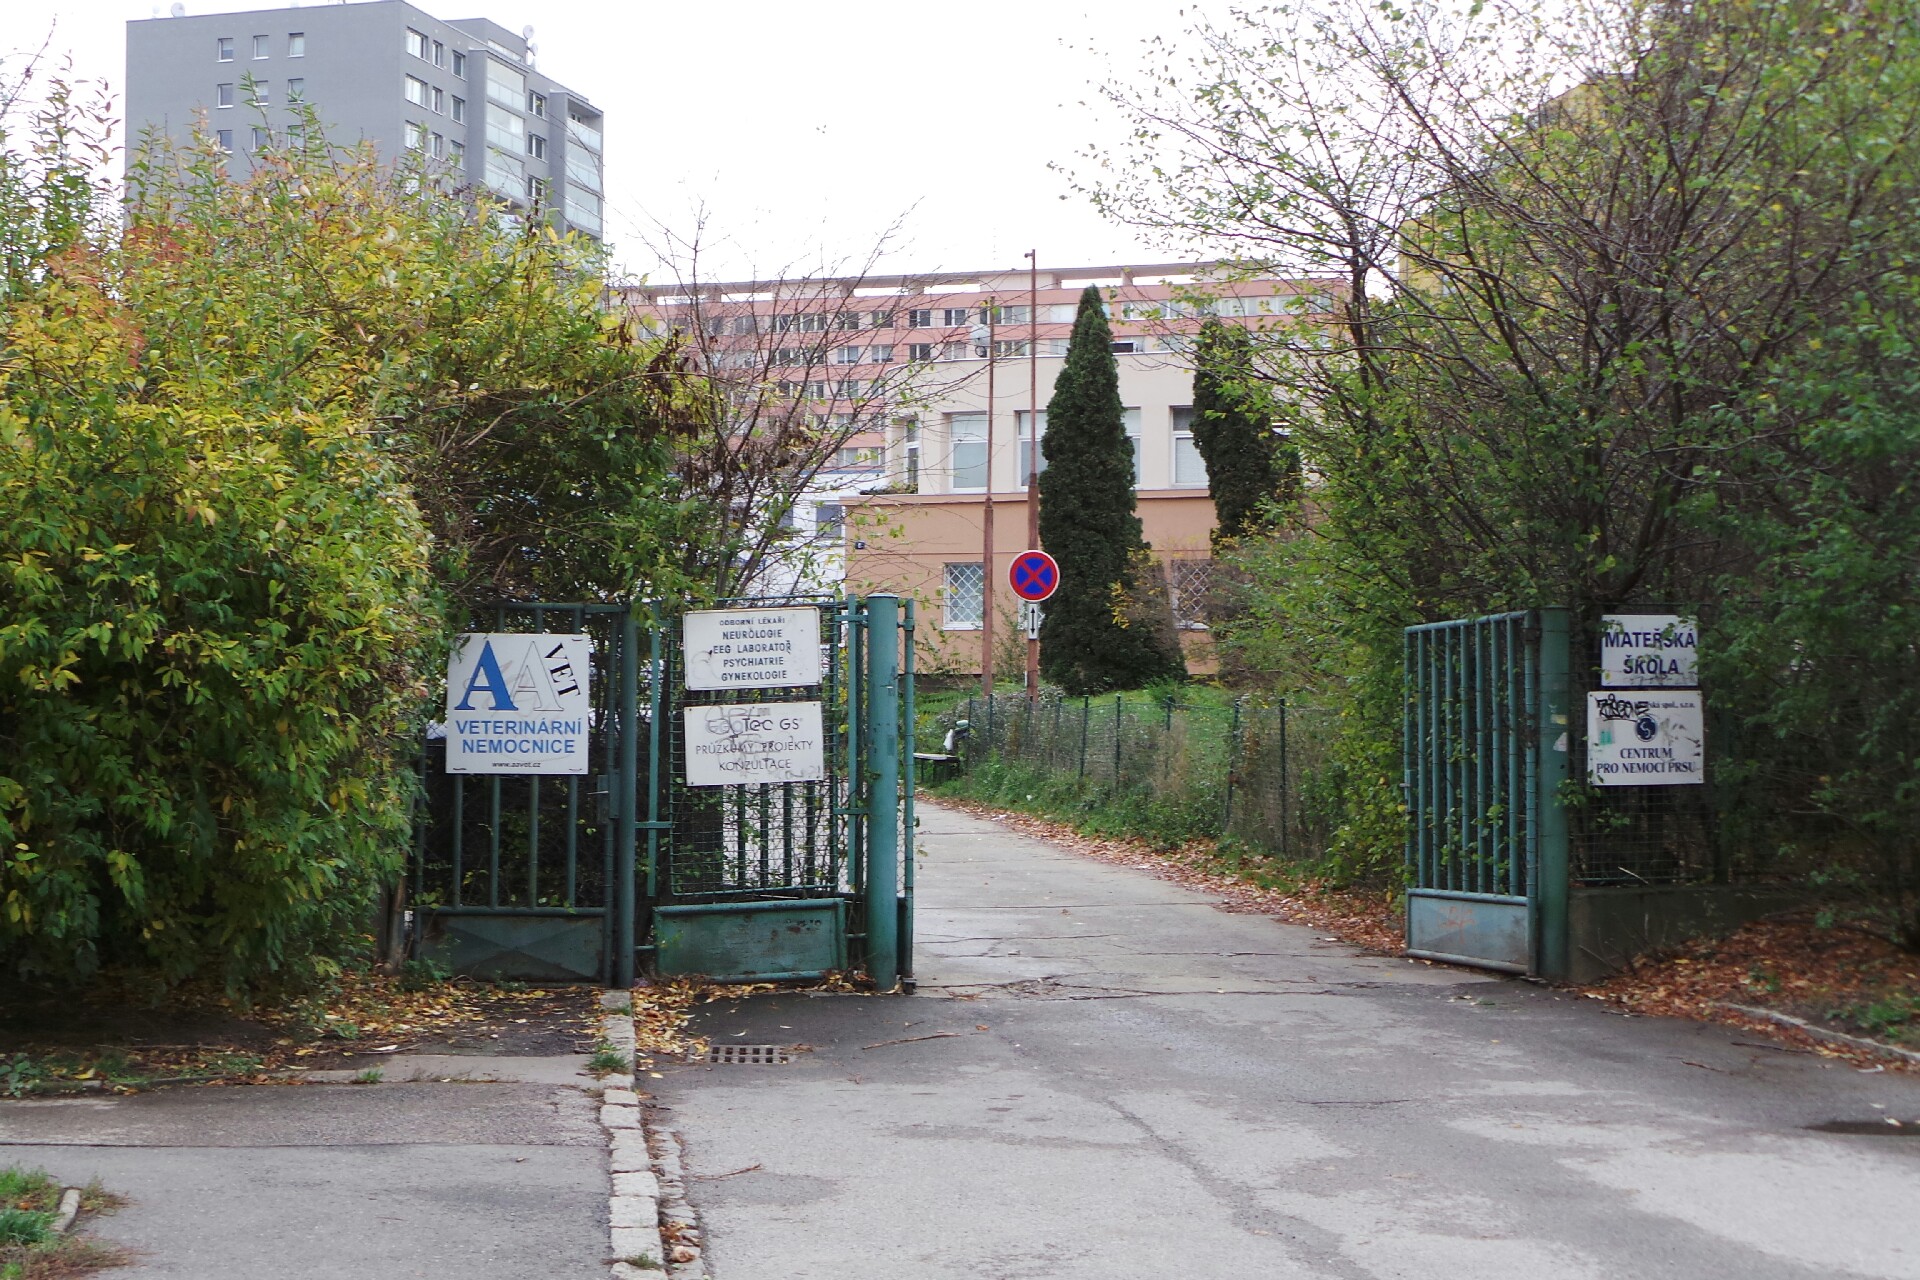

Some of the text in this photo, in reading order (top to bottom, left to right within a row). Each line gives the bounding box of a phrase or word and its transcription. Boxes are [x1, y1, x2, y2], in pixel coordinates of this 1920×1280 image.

[719, 616, 785, 626] ODBORNÍ LÉKAŘI
[722, 629, 783, 640] NEUROLOGIE
[1605, 628, 1696, 648] MATEŘSKÁ
[713, 640, 792, 654] EEG LABORATOŘ
[723, 656, 784, 668] PSYCHIATRIE
[1623, 654, 1680, 674] ŠKOLA
[544, 642, 581, 698] VET
[721, 670, 788, 682] GYNEKOLOGIE
[455, 717, 582, 735] VETERINÁRNÍ
[779, 718, 800, 731] GS
[462, 739, 575, 754] NEMOCNICE
[762, 740, 813, 752] PROJEKTY
[1620, 748, 1673, 759] CENTRUM
[719, 758, 792, 771] KONZULTACE
[1596, 761, 1697, 774] PRO NEMOCI PRSU
